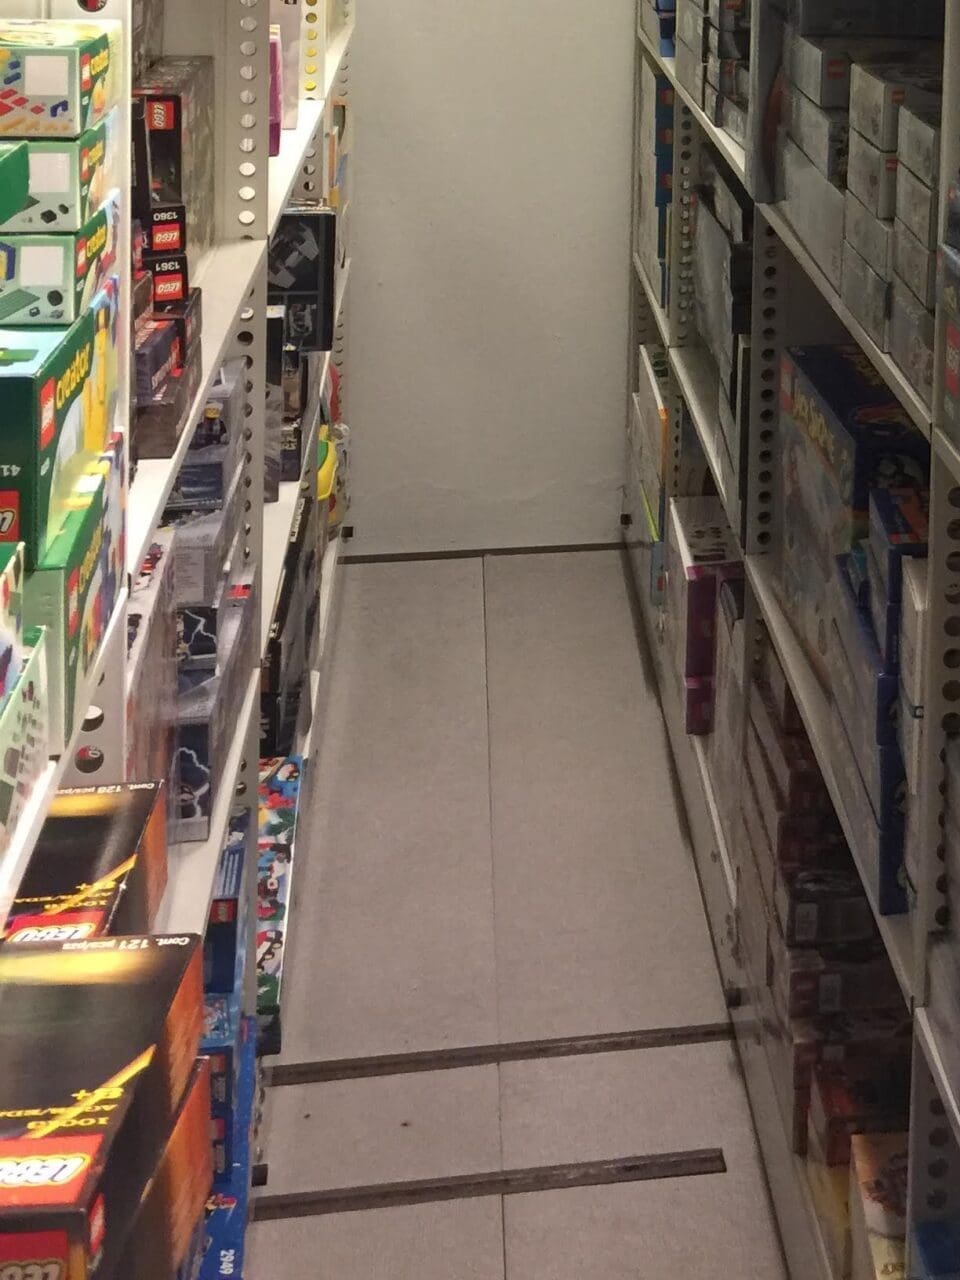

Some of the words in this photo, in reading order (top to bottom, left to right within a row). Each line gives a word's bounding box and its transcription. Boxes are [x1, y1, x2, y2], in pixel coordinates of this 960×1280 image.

[153, 102, 166, 129] LEGO
[153, 212, 178, 222] 1360
[155, 231, 179, 244] LEGO
[155, 261, 181, 271] 1361
[157, 281, 181, 296] LEGO
[118, 940, 149, 950] 121
[154, 936, 190, 946] Cont.
[218, 1249, 237, 1275] 2949
